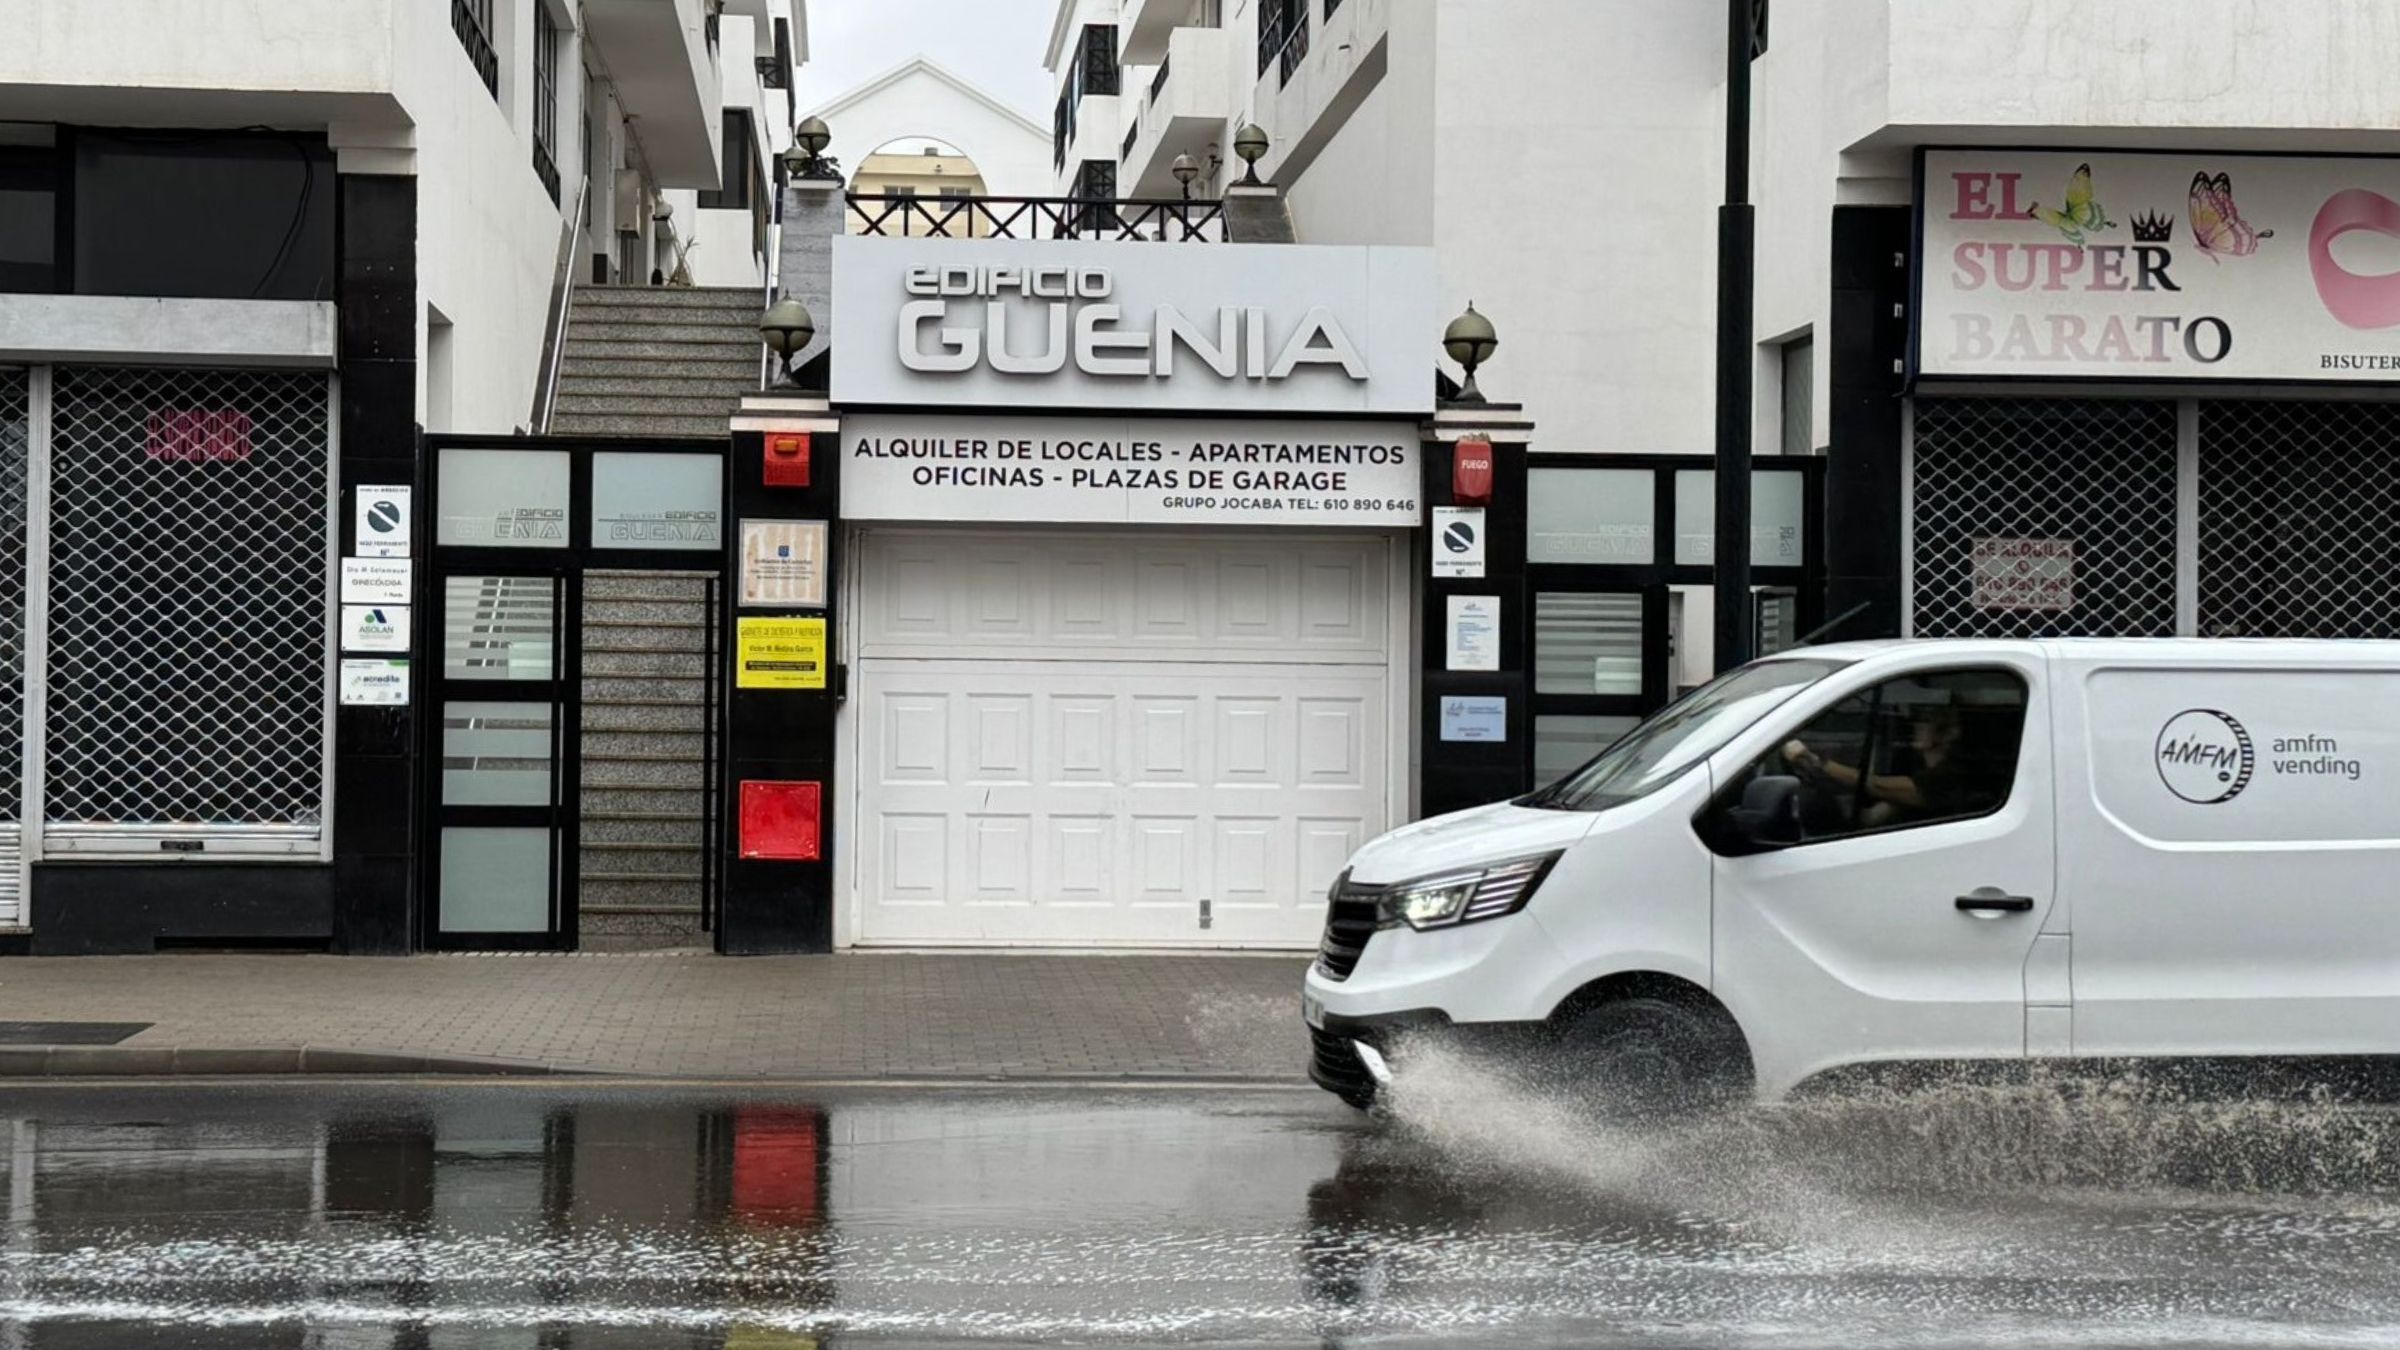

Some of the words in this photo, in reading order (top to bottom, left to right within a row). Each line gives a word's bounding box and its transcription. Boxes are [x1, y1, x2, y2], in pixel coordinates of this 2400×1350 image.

[1949, 172, 2034, 221] EL
[1951, 241, 2182, 292] SUPER
[905, 264, 1113, 299] EDIFICIO
[897, 299, 1371, 381] GUENIA
[1948, 313, 2233, 364] BARATO
[854, 438, 988, 460] ALQUILER
[997, 440, 1032, 460] DE
[1041, 441, 1162, 462] LOCALES
[1188, 442, 1405, 464] APARTAMENTOS
[1461, 459, 1489, 470] FUEGO
[912, 466, 1044, 487] OFICINAS
[1072, 468, 1179, 489] PLAZAS
[1188, 469, 1224, 490] DE
[1232, 470, 1347, 491] GARAGE
[1162, 496, 1216, 510] GRUPO
[1220, 497, 1283, 510] JOCABA
[1287, 498, 1319, 510] TEL:
[1323, 498, 1349, 511] 610
[1353, 499, 1382, 511] 890
[1386, 499, 1415, 512] 646
[610, 522, 716, 541] GUENIA
[2272, 733, 2337, 753] amfm
[2272, 756, 2361, 781] vending
